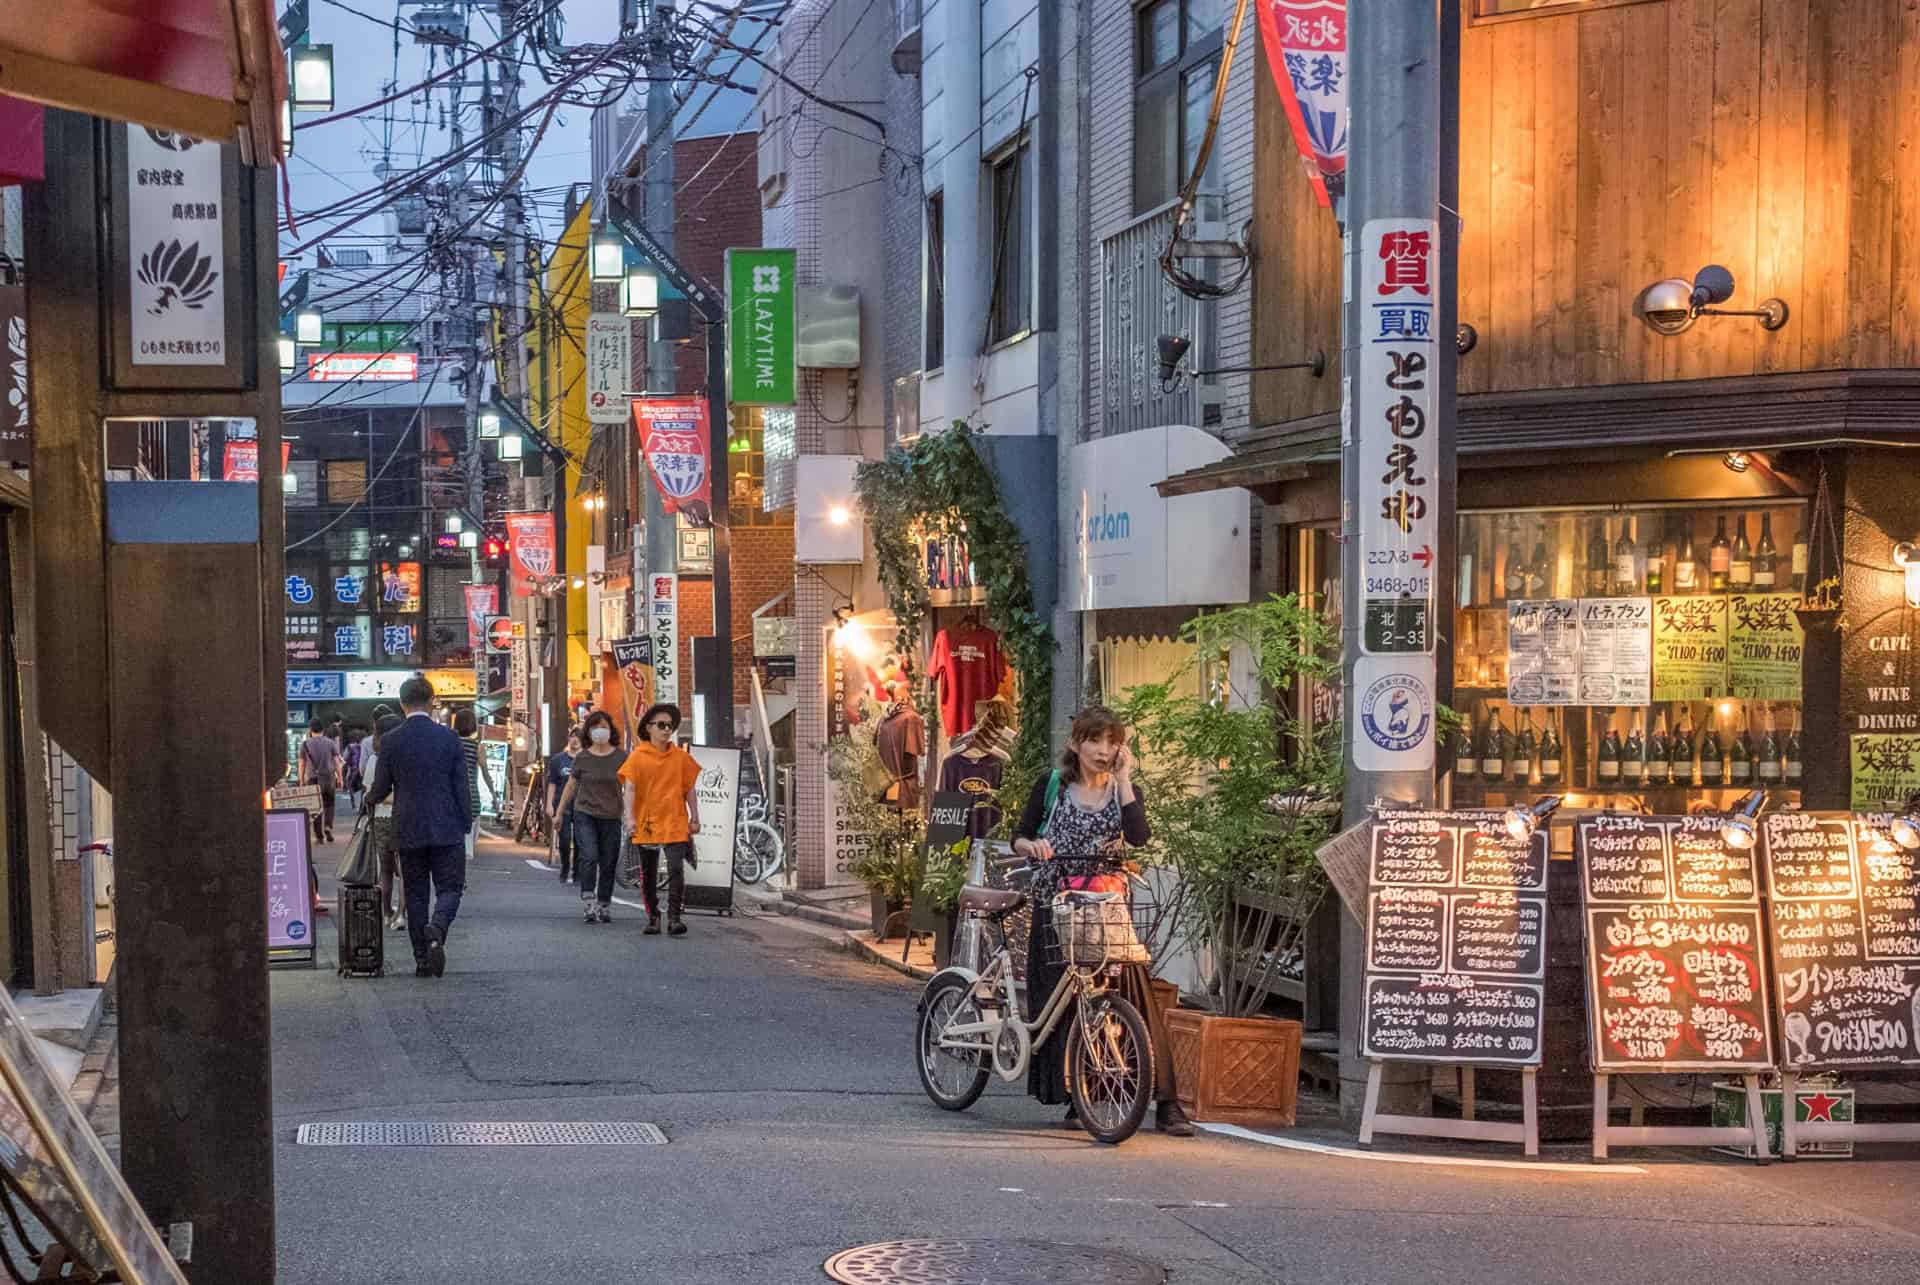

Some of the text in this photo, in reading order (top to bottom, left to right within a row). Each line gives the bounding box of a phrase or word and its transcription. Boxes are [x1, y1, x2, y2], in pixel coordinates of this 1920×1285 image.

[137, 168, 184, 186] 家内安全
[1378, 230, 1431, 296] 質
[1380, 309, 1429, 336] 買取
[1381, 351, 1426, 534] ともえや
[1368, 550, 1409, 564] ここ入る
[1662, 613, 1717, 632] 大募集
[1736, 612, 1793, 632] 大募集
[657, 617, 672, 681] ともえや
[1883, 662, 1896, 676] &
[1867, 687, 1911, 702] WINE
[1859, 714, 1917, 729] DINING
[931, 808, 969, 826] PRESALE
